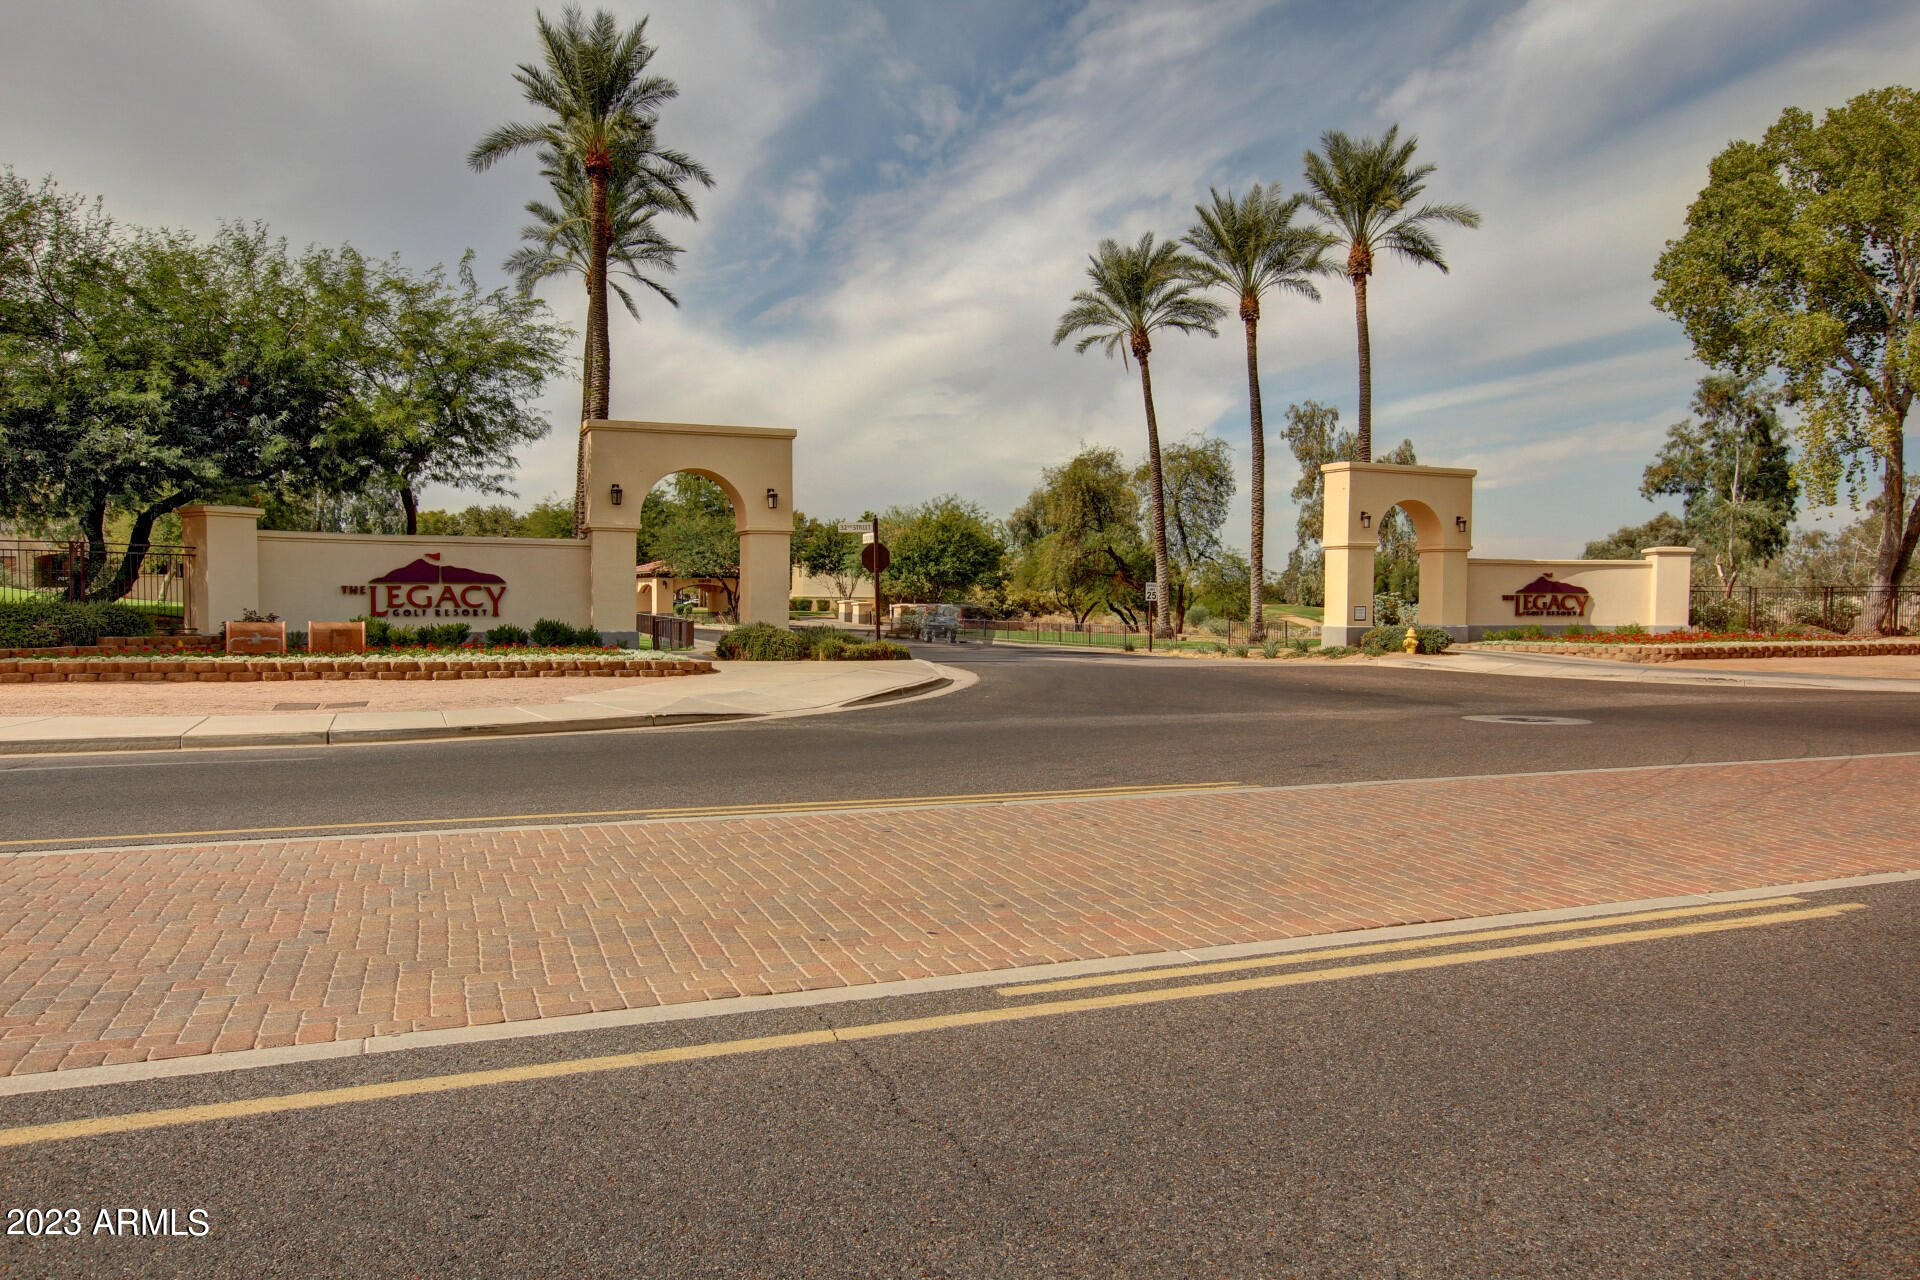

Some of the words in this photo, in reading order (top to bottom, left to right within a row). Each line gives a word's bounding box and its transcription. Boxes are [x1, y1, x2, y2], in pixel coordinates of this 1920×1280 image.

[341, 585, 366, 595] THE
[368, 585, 507, 617] LEGACY
[1147, 592, 1157, 600] 25
[1514, 594, 1589, 616] LEGACY
[392, 609, 427, 617] GOLF
[434, 609, 487, 617] RESORT
